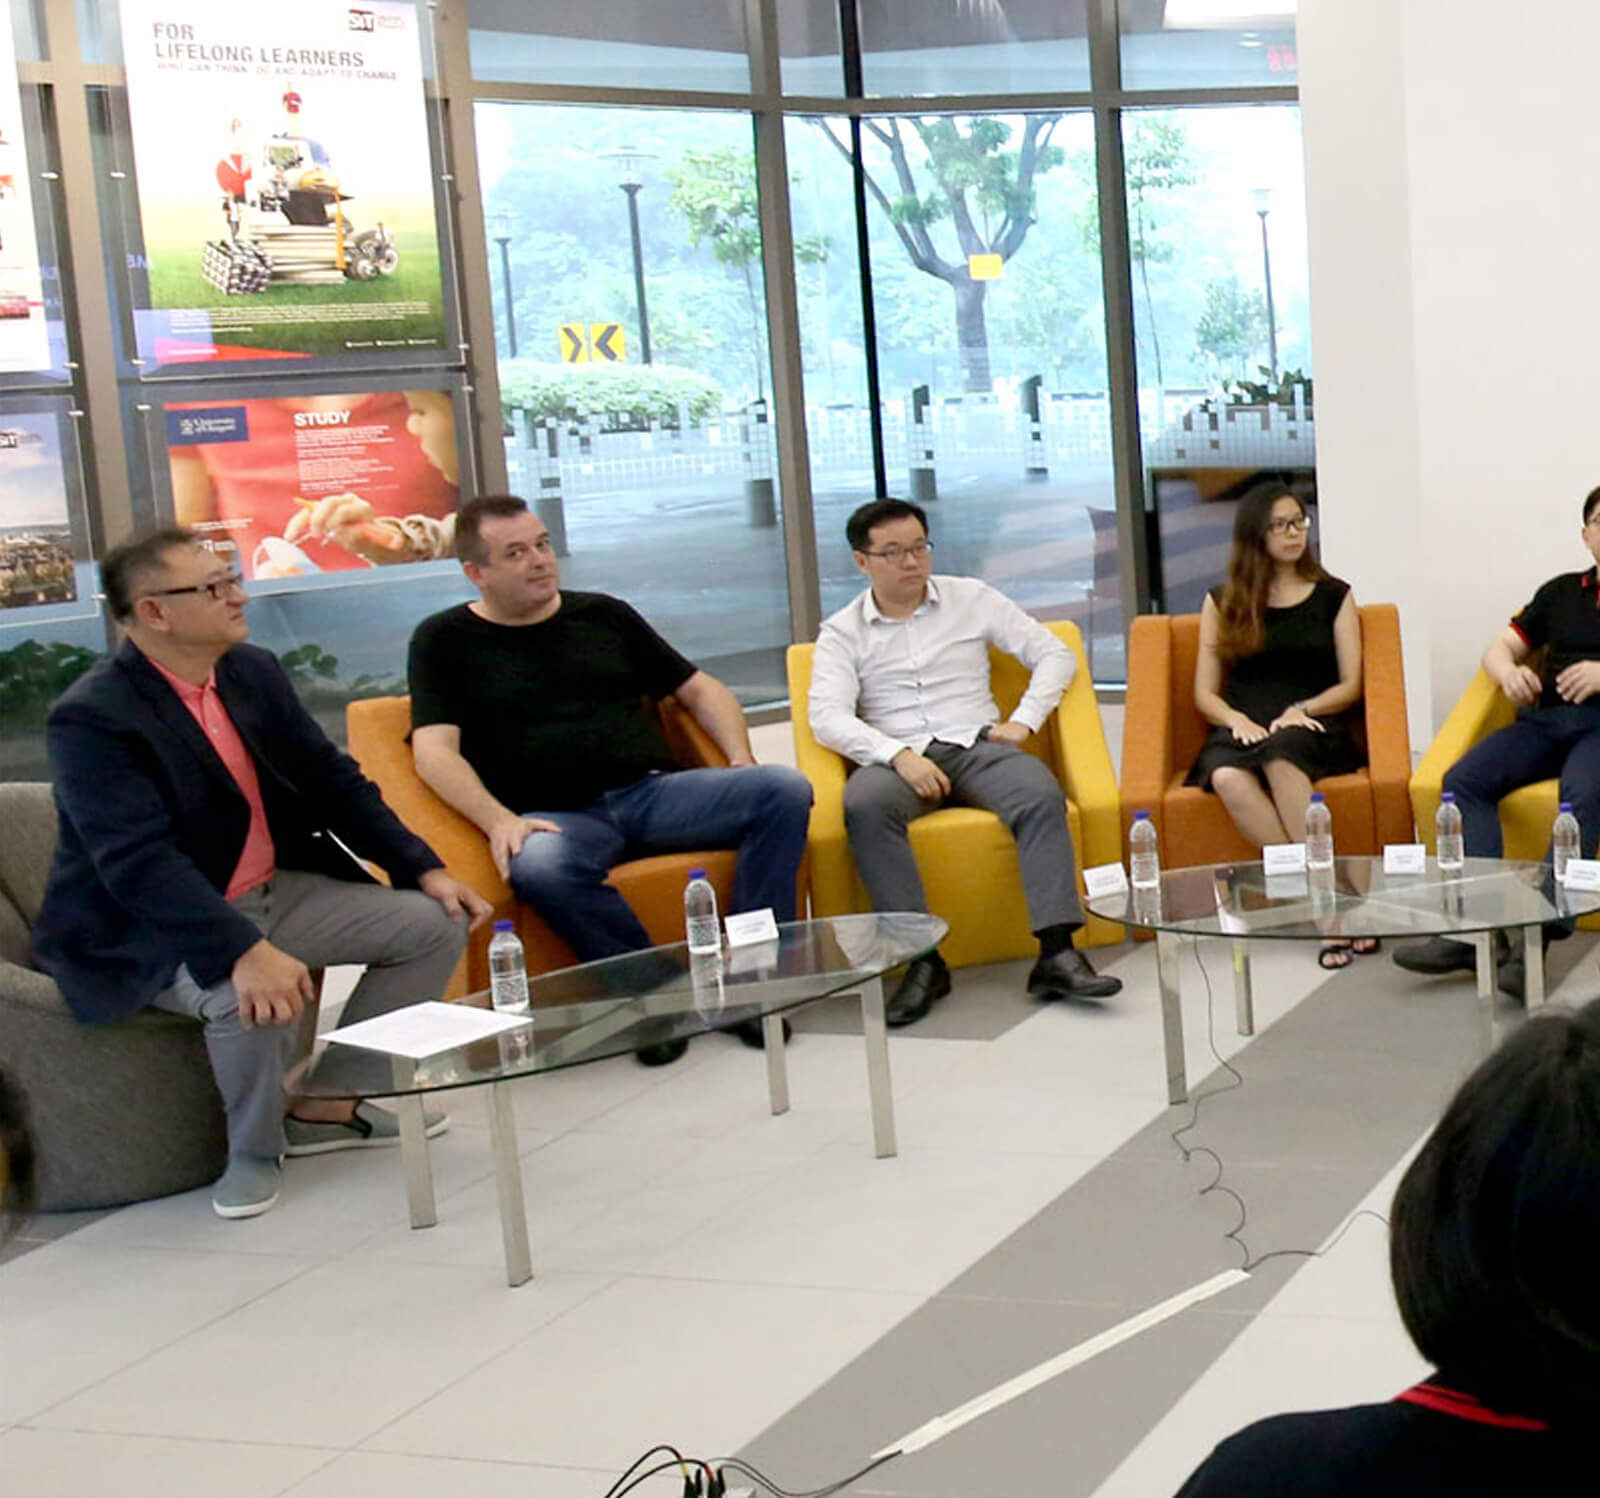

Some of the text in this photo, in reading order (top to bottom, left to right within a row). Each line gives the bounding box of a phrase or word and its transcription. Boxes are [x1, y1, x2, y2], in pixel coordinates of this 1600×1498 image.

[153, 22, 194, 40] FOR
[156, 42, 364, 67] LIFELONG LEARNERS
[294, 410, 351, 427] STUDY
